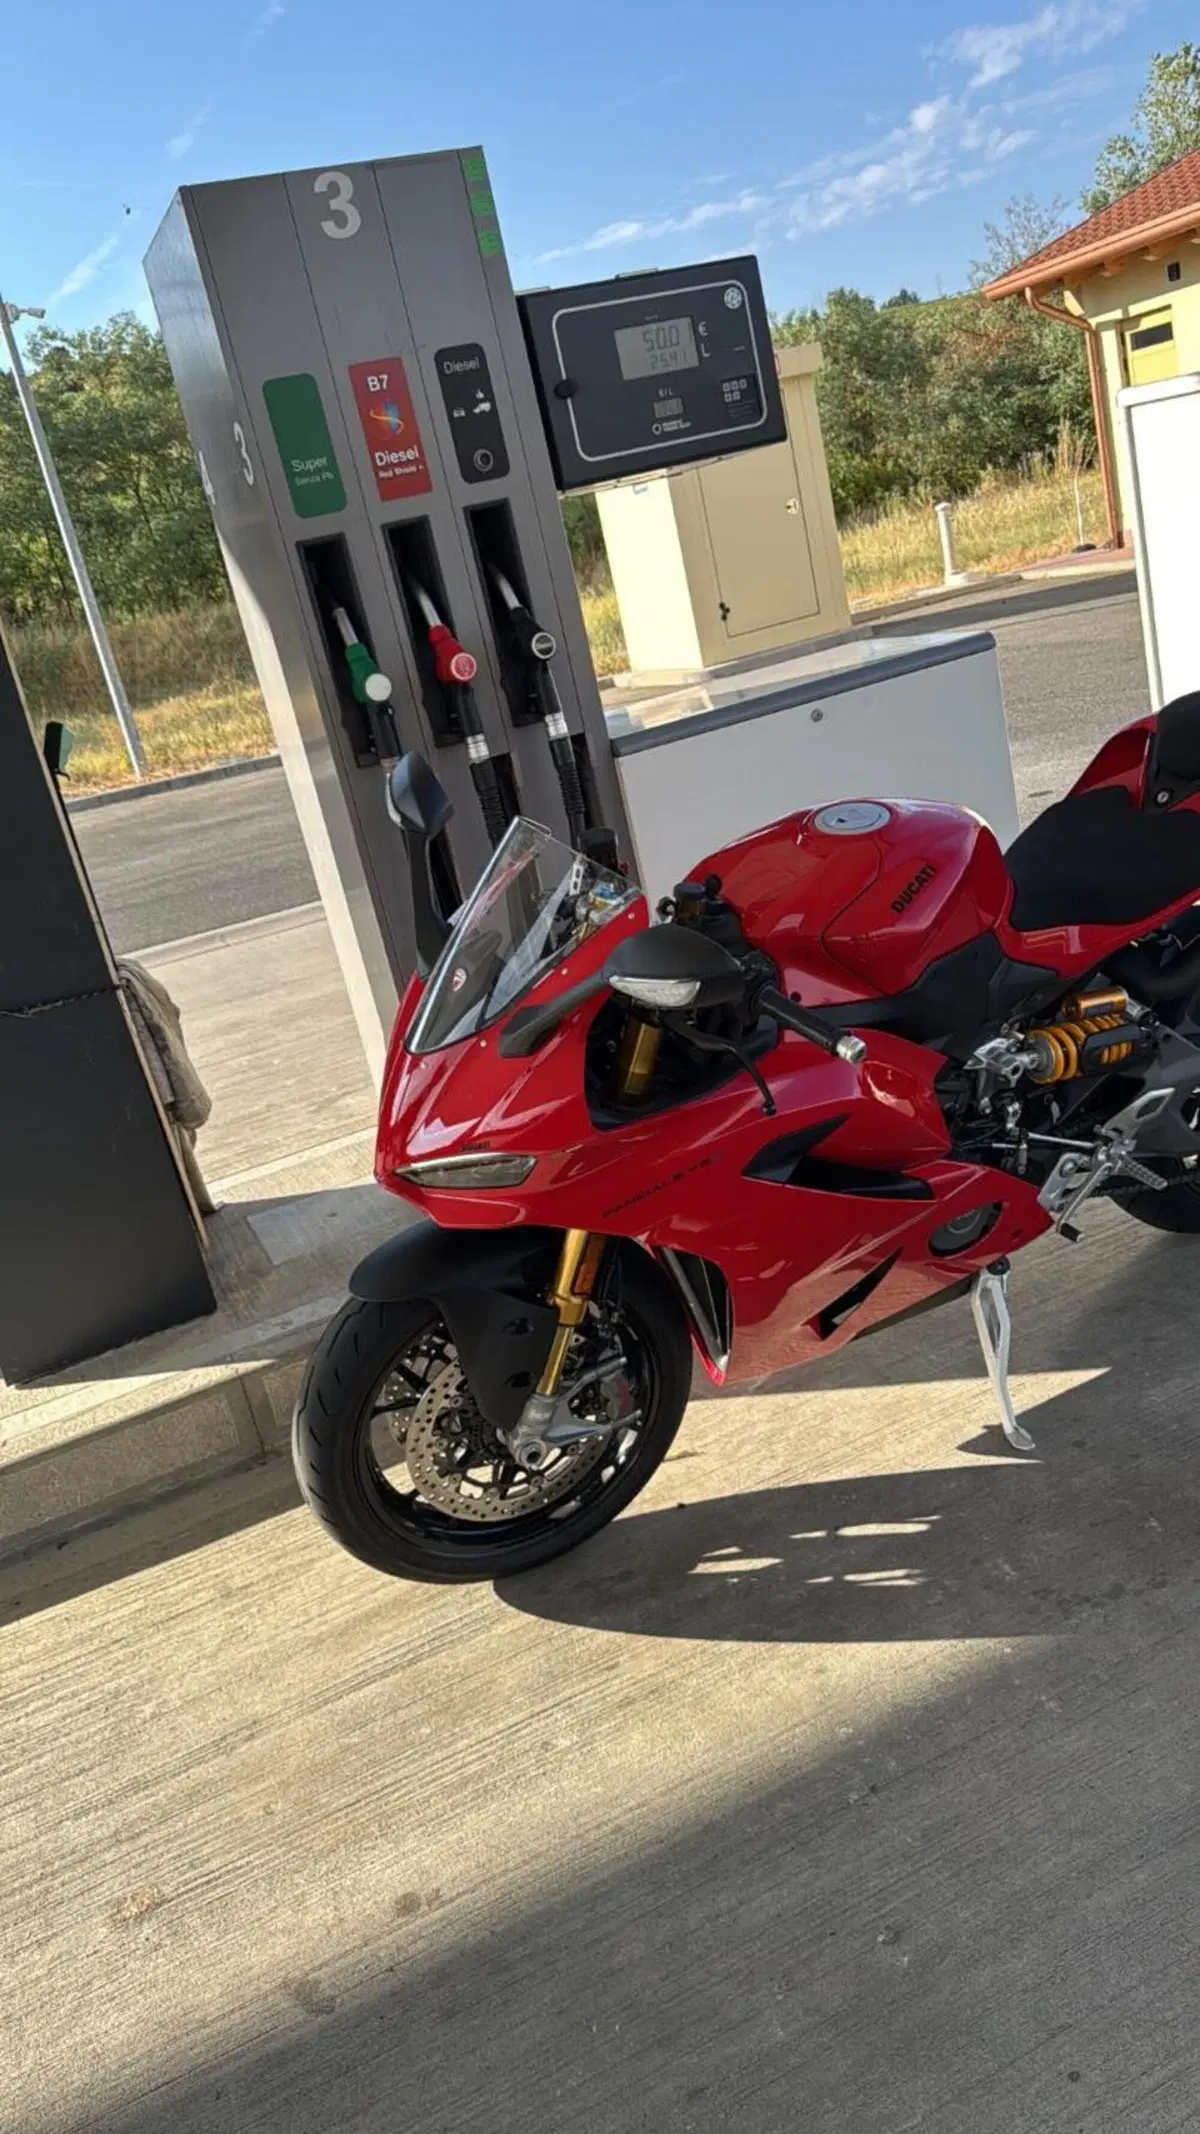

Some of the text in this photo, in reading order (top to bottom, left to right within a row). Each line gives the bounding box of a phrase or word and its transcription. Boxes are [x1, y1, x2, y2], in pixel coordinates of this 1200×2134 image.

[313, 171, 362, 239] 3
[700, 343, 711, 357] L
[443, 356, 480, 374] Diesel
[367, 374, 389, 392] B7
[233, 421, 255, 486] 3
[374, 444, 420, 466] Diesel
[291, 456, 328, 473] Super
[890, 863, 937, 914] DUCATI
